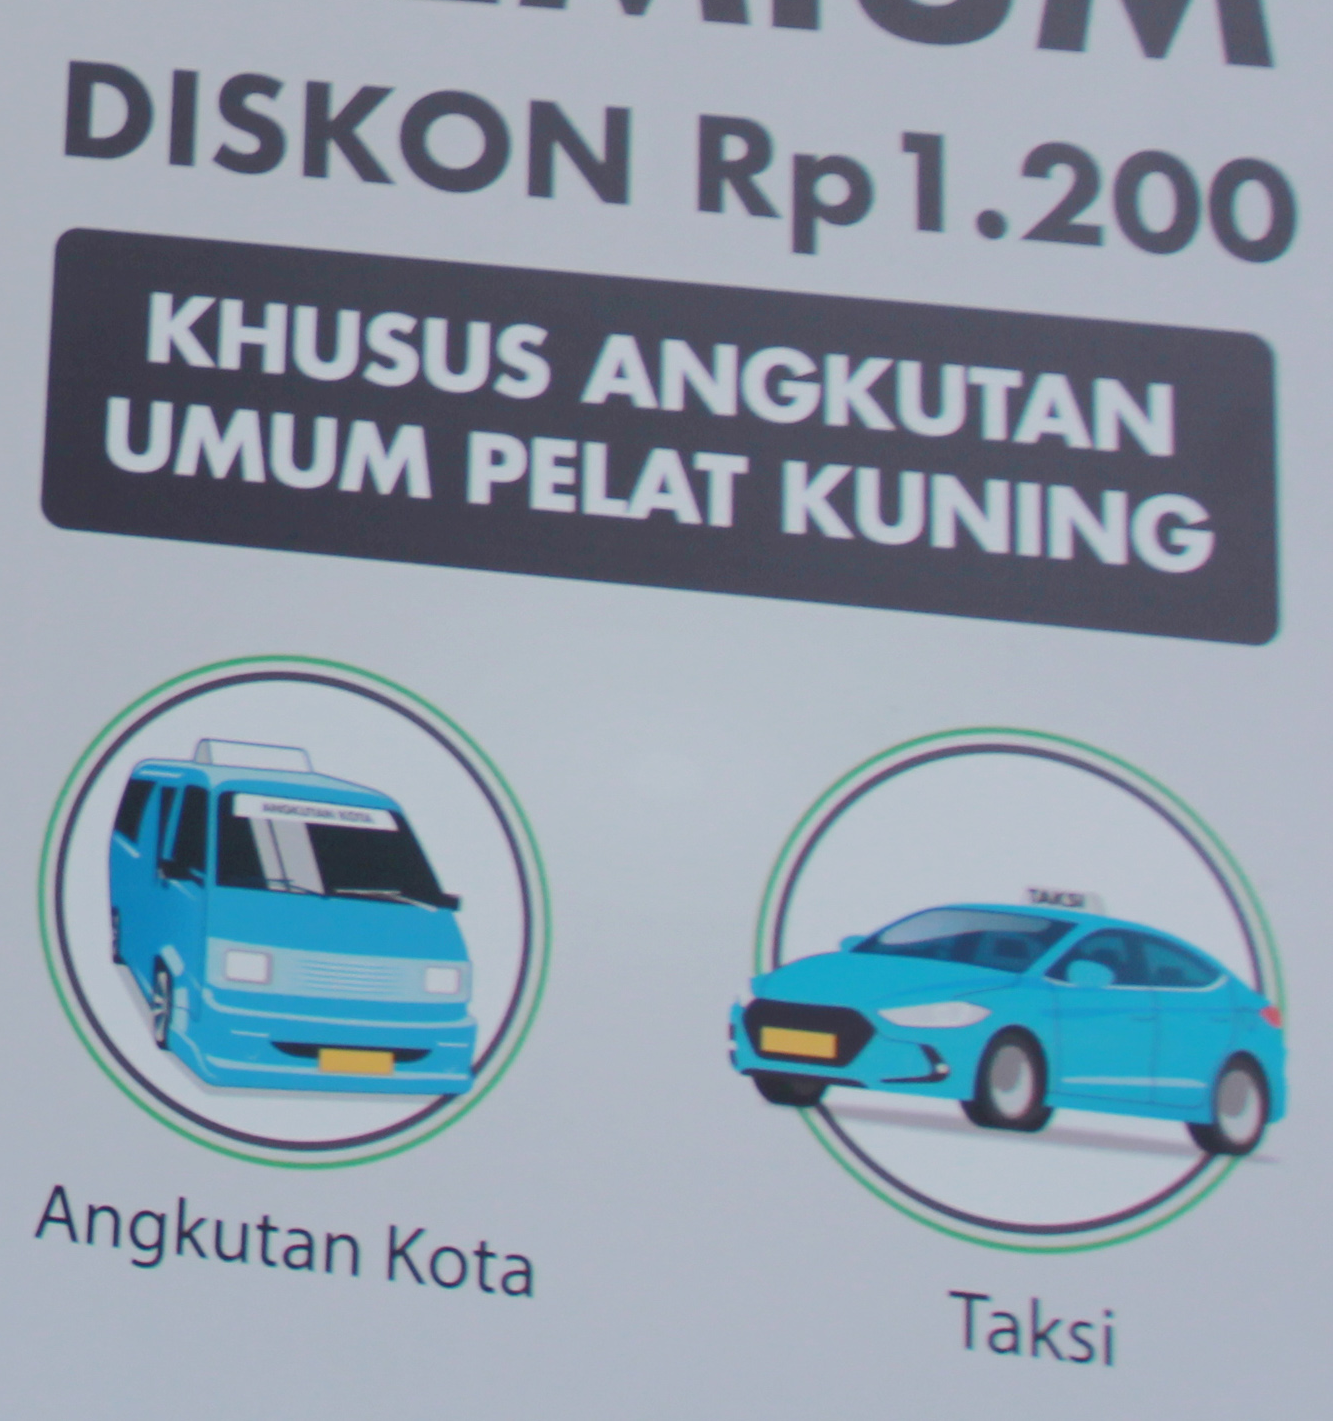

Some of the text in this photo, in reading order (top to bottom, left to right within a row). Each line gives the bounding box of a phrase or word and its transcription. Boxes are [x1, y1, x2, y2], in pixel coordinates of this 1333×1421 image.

[63, 59, 1299, 264] DISKON Rp1.200
[145, 291, 1175, 458] KHUSUS ANGKUTAN
[104, 396, 1215, 574] UMUM PELAT KUNING
[1026, 887, 1085, 908] TAKSI
[34, 1183, 535, 1299] Angkutan Kota
[947, 1289, 1116, 1367] Taksi
